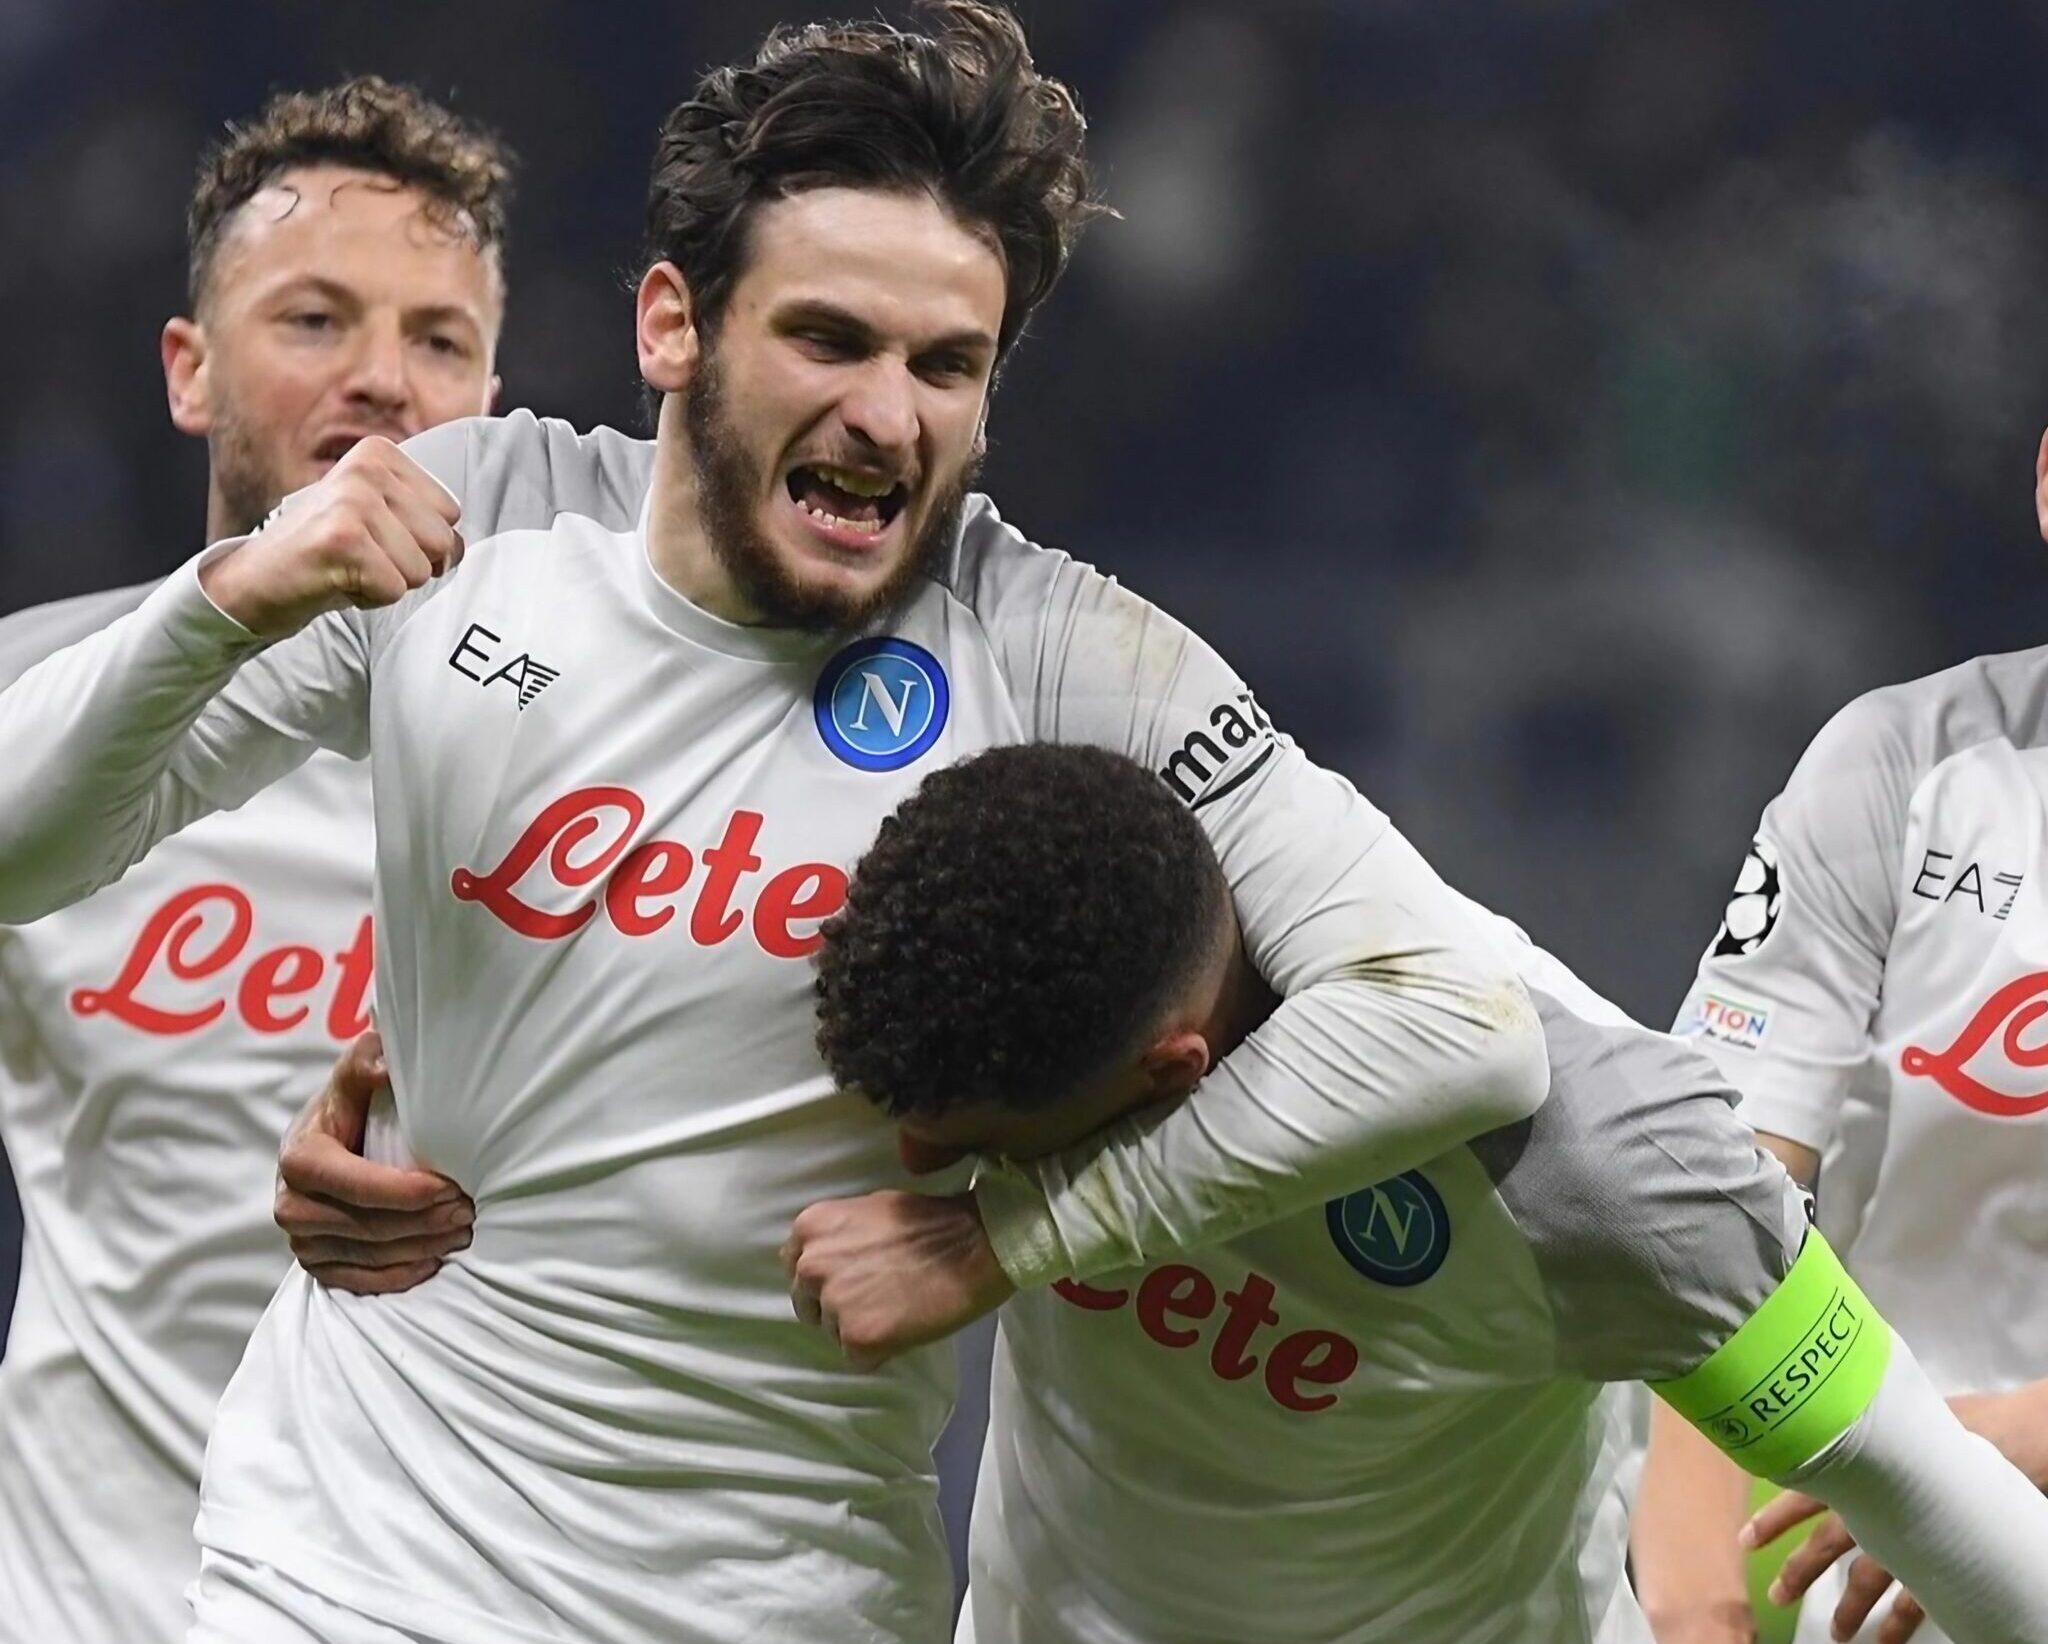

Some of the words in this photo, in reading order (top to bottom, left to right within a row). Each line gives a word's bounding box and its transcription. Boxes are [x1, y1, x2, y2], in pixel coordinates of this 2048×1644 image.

[850, 672, 917, 737] N
[451, 787, 850, 958] Lete
[1359, 1185, 1420, 1255] N
[1052, 1264, 1358, 1412] ete
[1750, 1296, 1856, 1423] RESPECT
